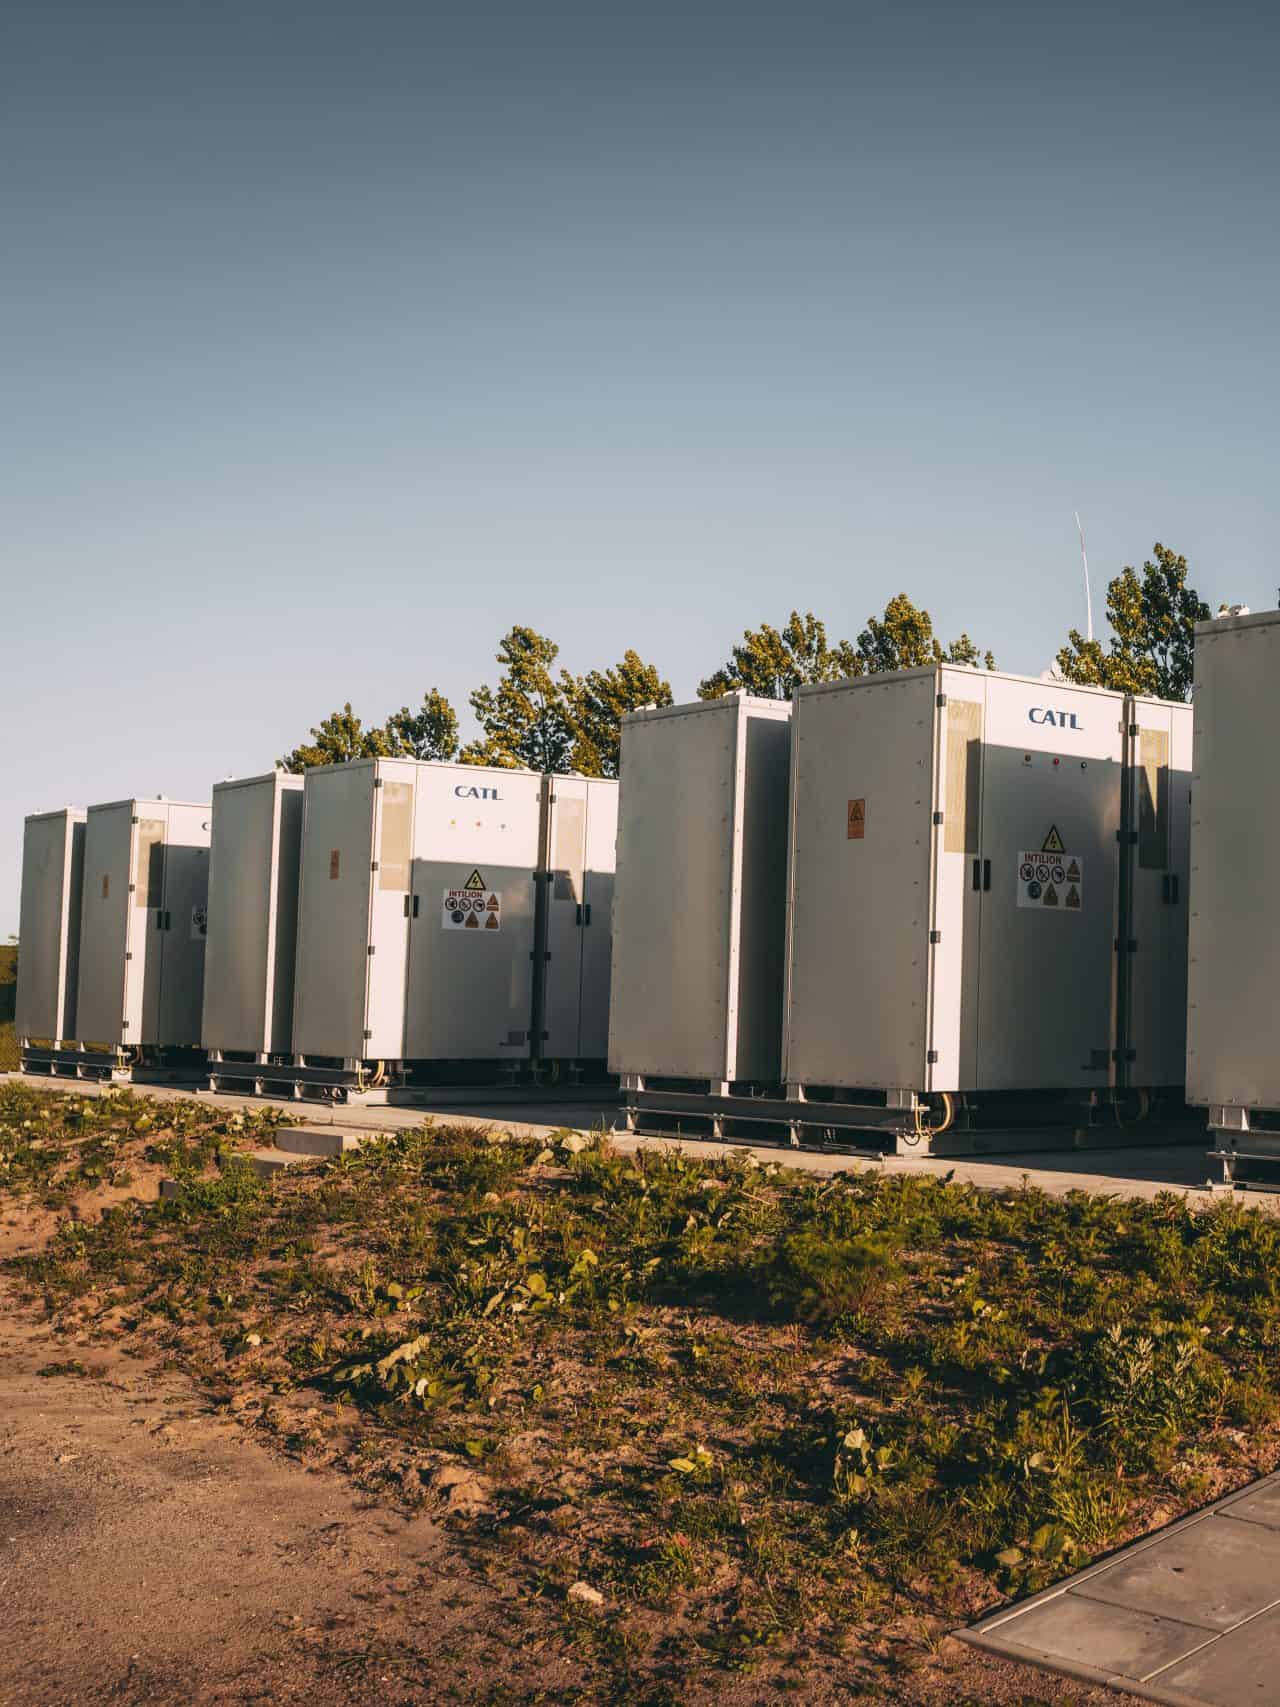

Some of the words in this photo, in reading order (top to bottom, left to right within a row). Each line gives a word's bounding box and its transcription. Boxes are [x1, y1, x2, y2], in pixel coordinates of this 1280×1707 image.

[1029, 708, 1083, 730] CATL
[455, 785, 503, 800] CATL
[1024, 852, 1062, 865] INTILION
